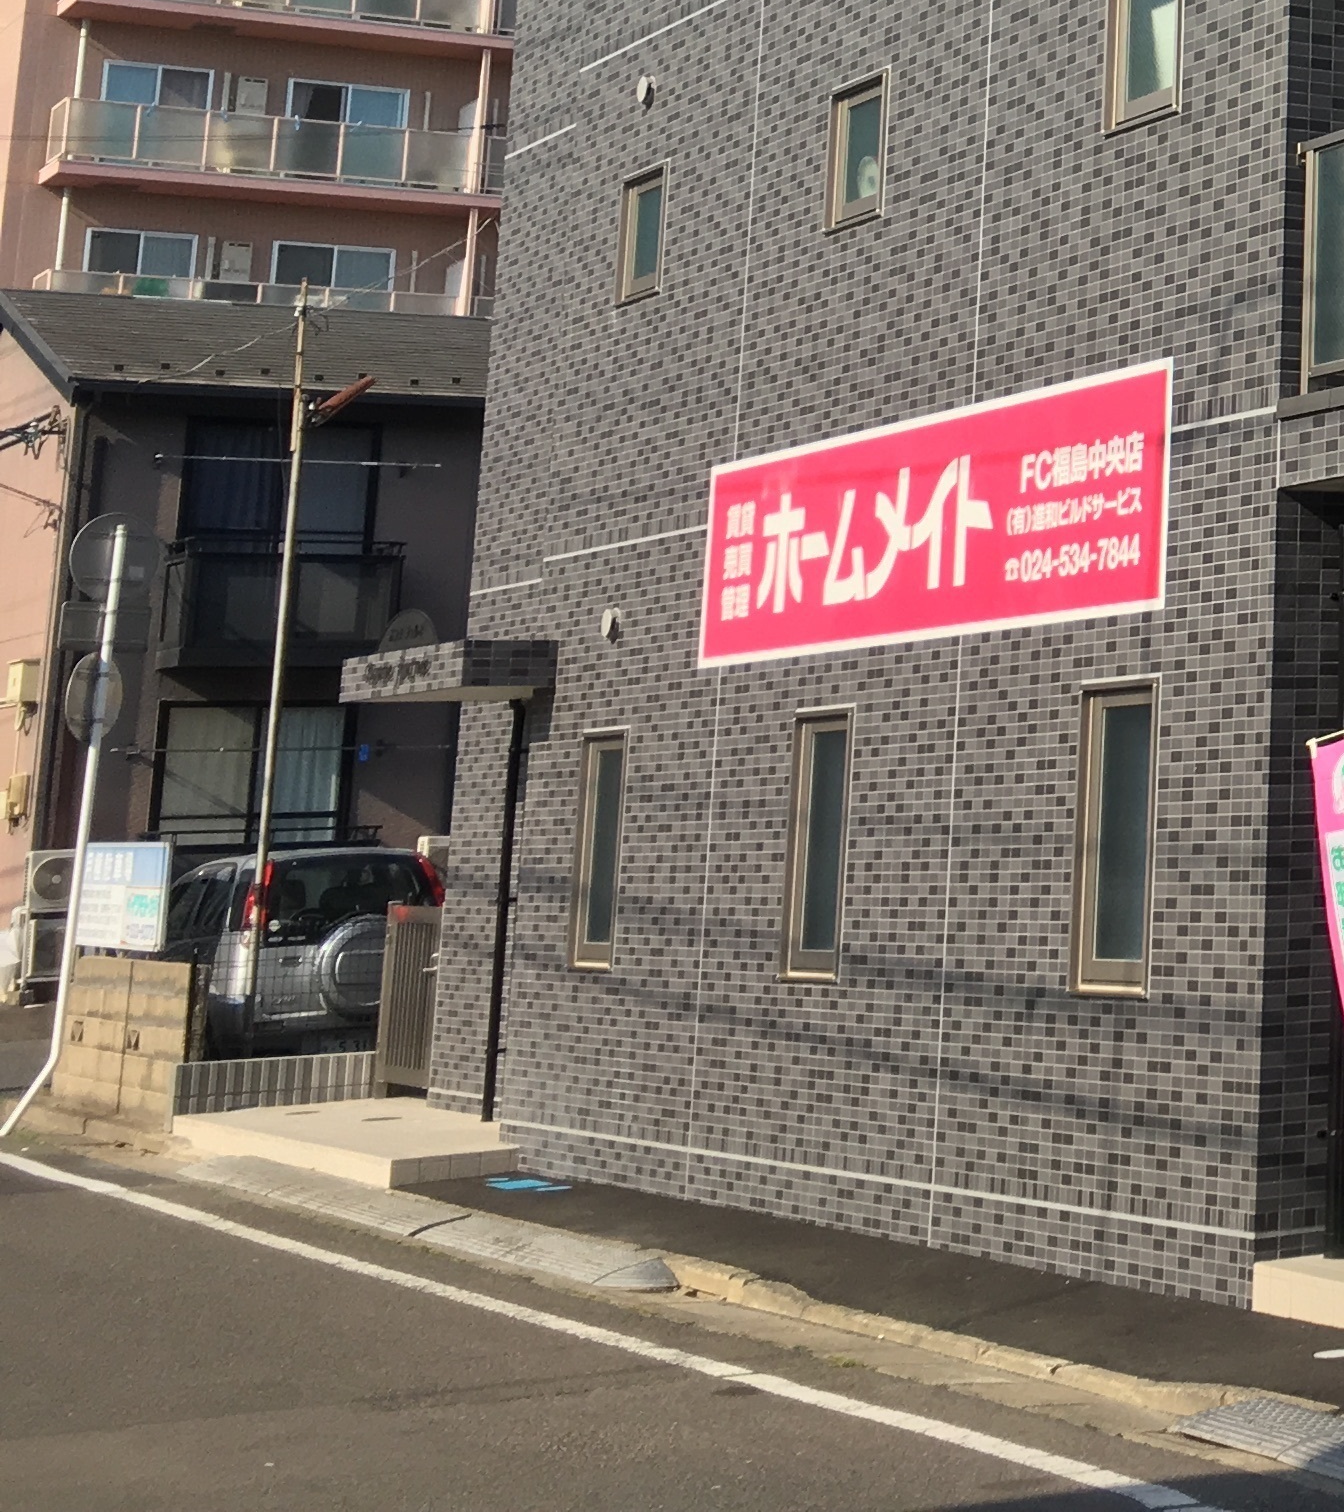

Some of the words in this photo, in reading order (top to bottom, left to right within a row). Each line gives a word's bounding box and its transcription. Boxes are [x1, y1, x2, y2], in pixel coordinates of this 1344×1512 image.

[1020, 431, 1144, 493] FC福島中央店
[726, 500, 756, 539] 賃貸
[757, 454, 993, 613] ホームメイト
[723, 541, 753, 580] 売買
[1020, 533, 1140, 582] 024-534-7844
[721, 583, 751, 622] 管理
